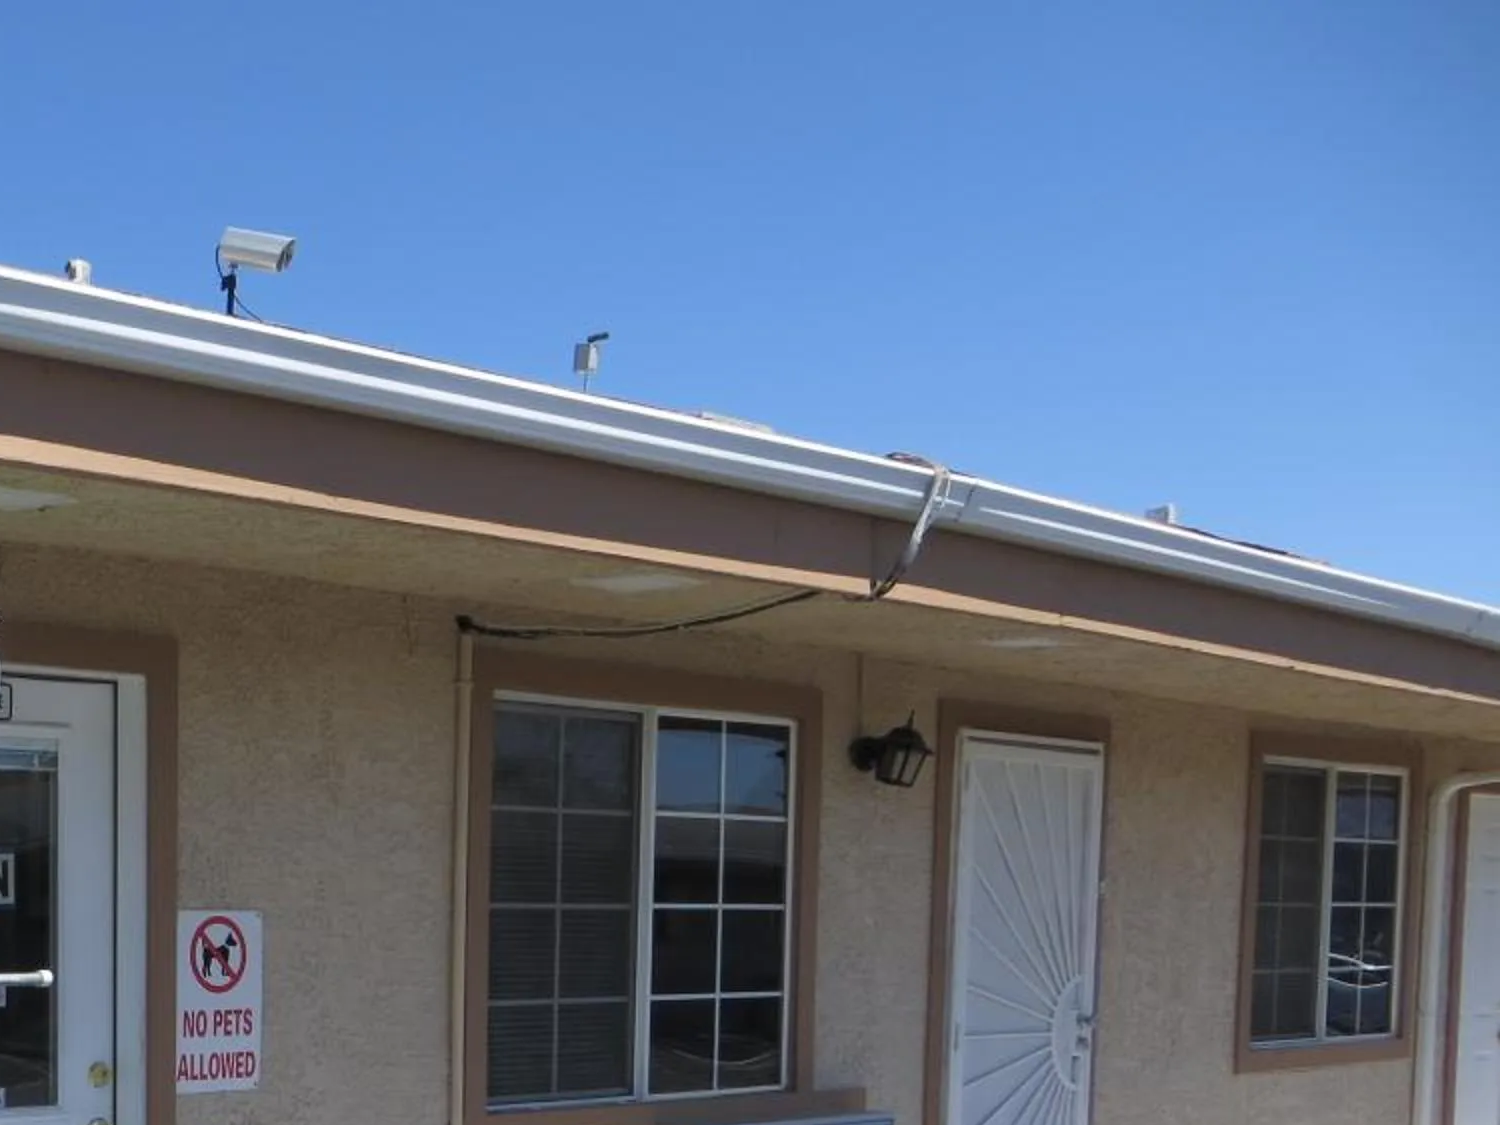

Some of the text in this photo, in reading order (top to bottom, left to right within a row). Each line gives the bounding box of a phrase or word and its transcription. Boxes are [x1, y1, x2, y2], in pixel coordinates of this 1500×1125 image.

[183, 1007, 253, 1038] NO PETS
[177, 1051, 256, 1082] ALLOWED
